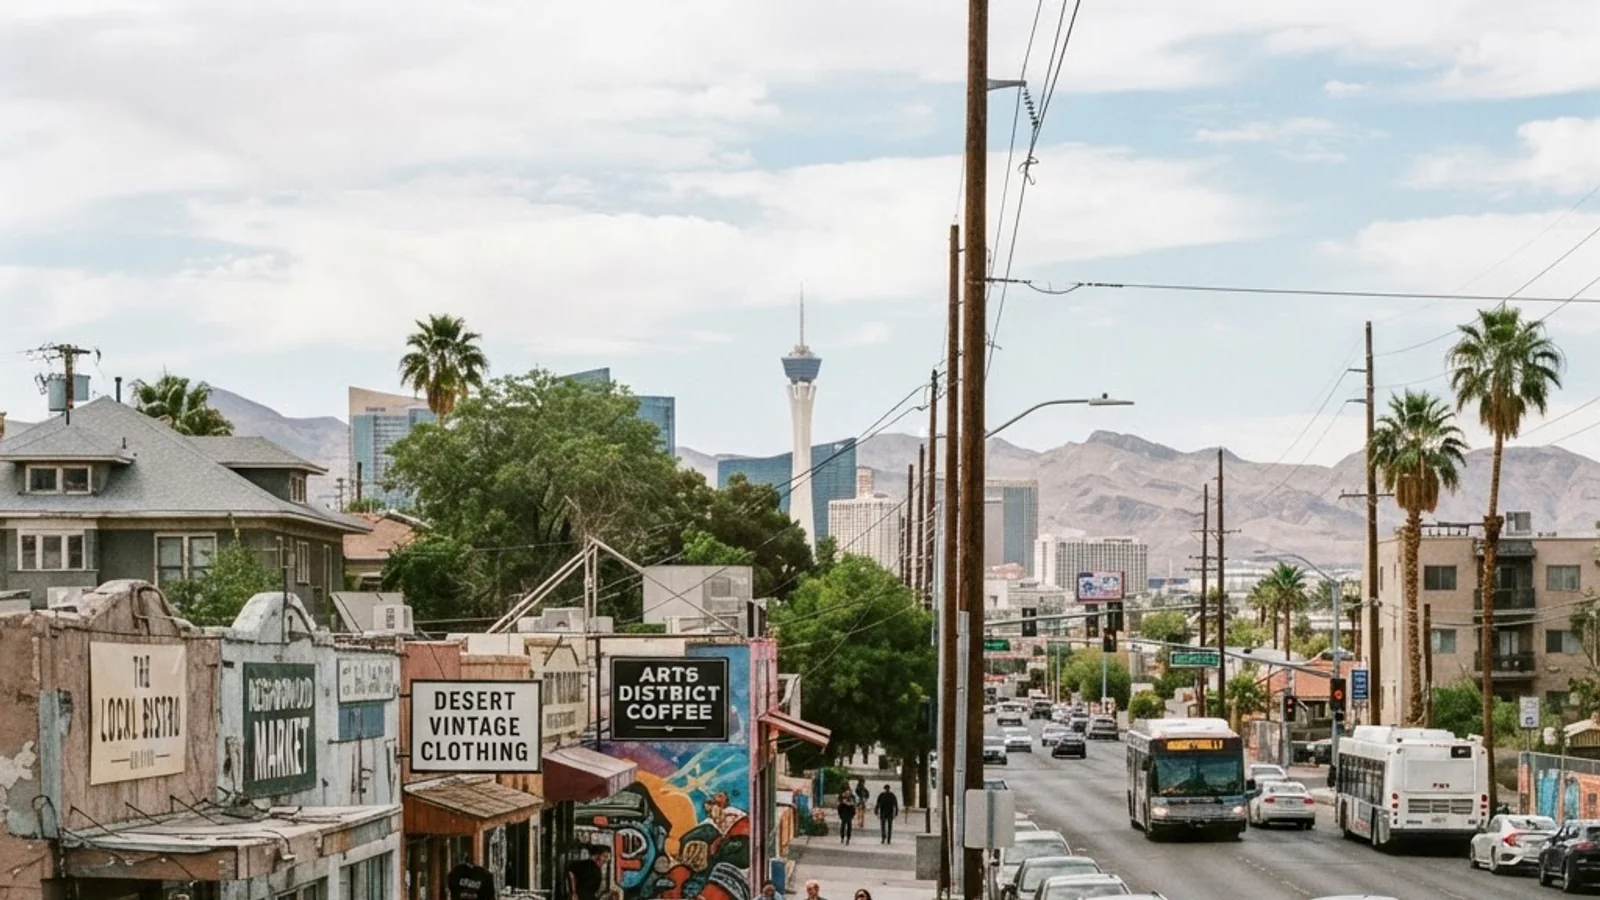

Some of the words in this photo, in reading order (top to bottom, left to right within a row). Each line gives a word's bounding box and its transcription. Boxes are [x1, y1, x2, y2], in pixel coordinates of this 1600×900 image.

[133, 655, 150, 688] THE
[639, 666, 699, 683] ARTS
[434, 691, 516, 710] DESERT
[618, 685, 720, 701] DISTRICT
[101, 697, 138, 742] LOCAL
[142, 696, 180, 739] BISTRO
[626, 703, 712, 720] COFFEE
[429, 717, 520, 736] VINTAGE
[254, 717, 310, 781] MARKET
[421, 741, 528, 761] CLOTHING
